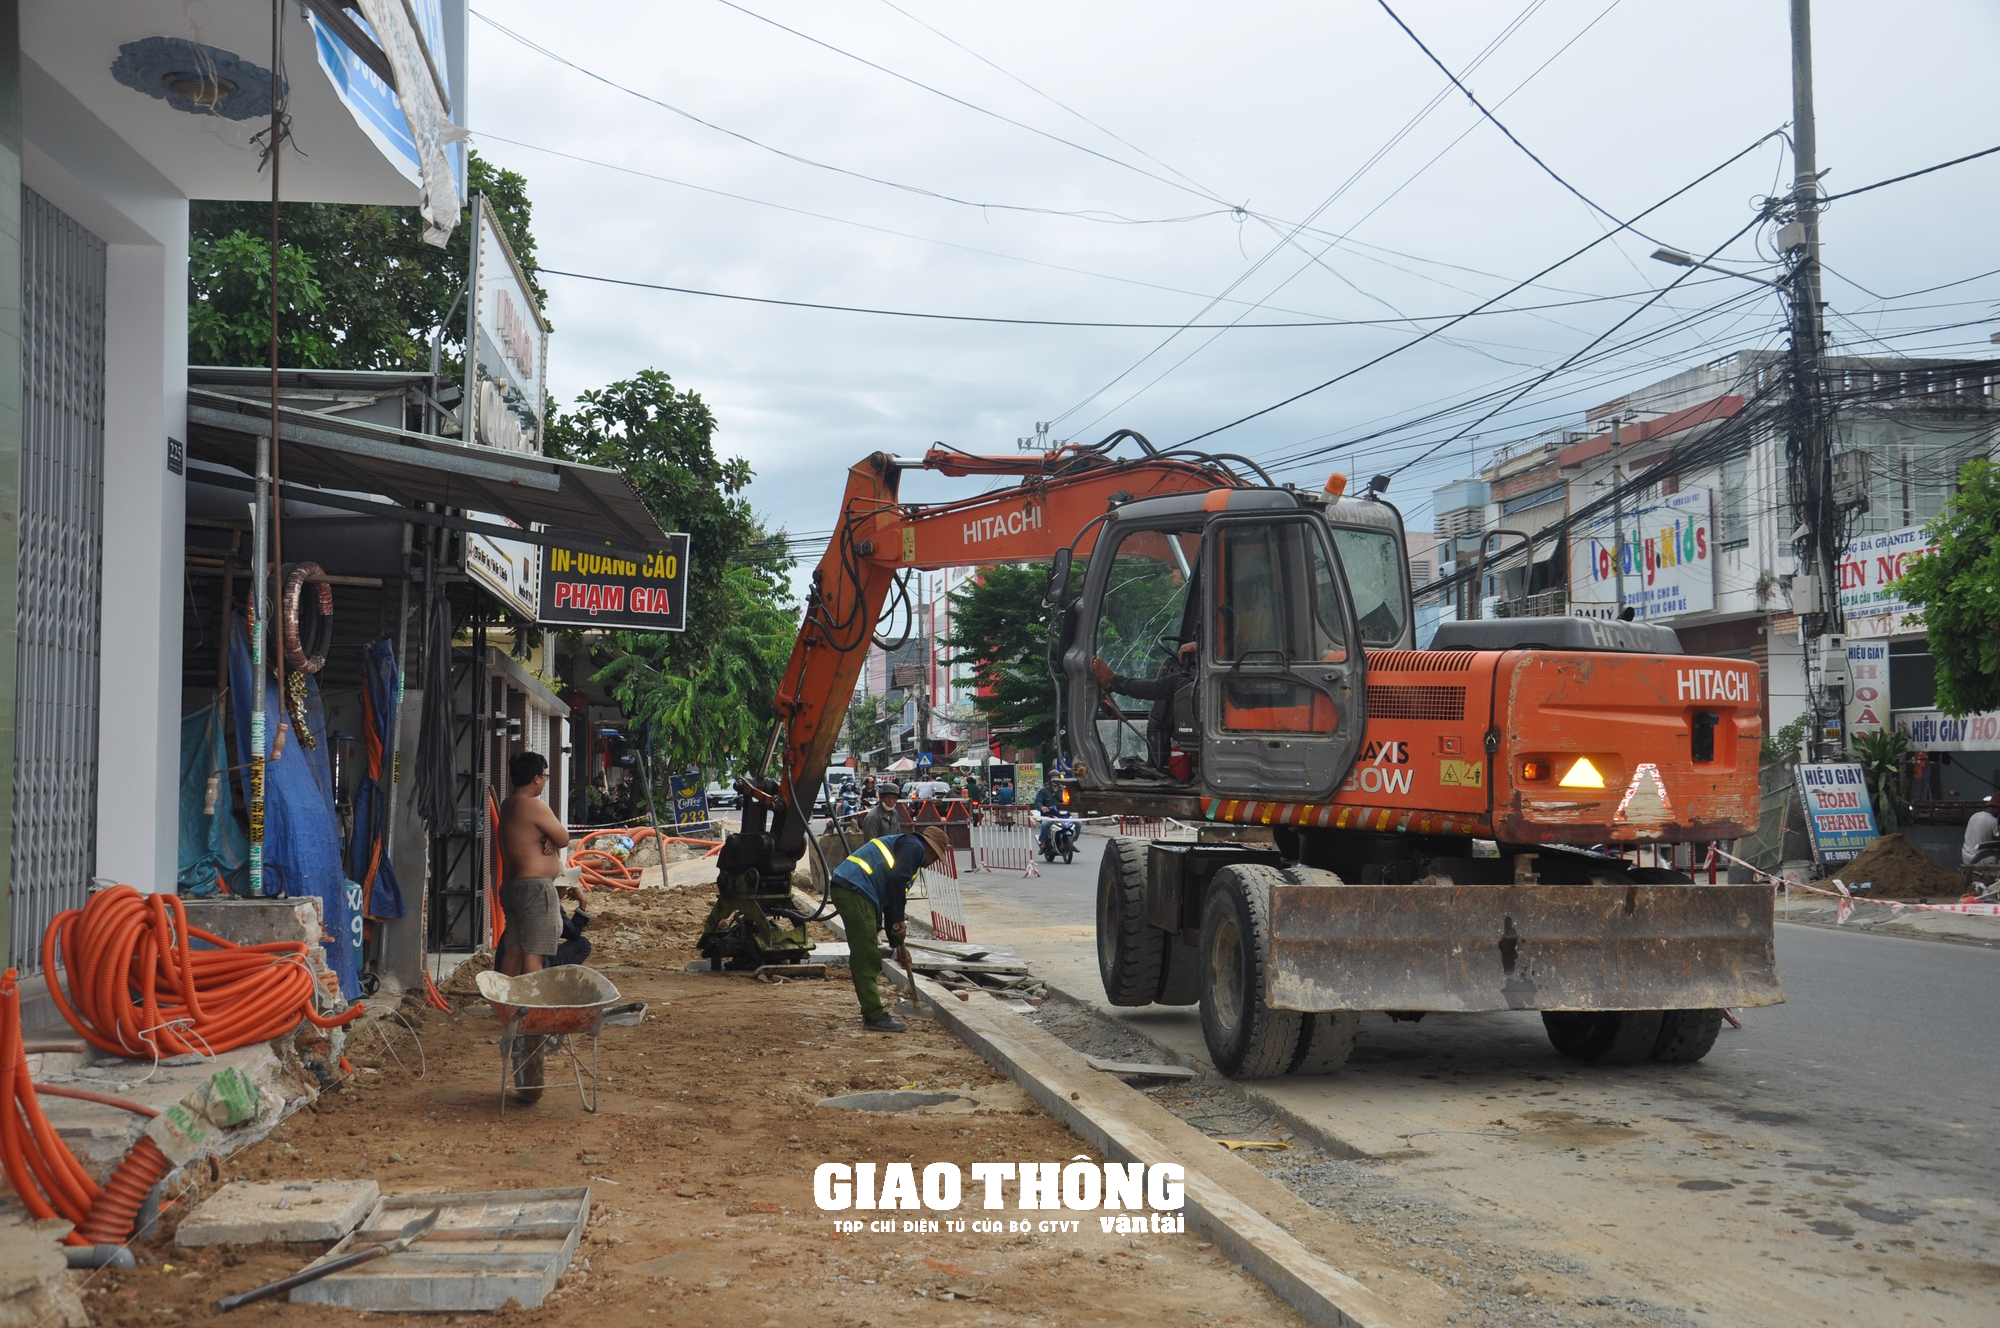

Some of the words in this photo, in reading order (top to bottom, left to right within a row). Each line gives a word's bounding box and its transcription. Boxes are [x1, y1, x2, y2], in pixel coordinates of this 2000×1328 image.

[170, 442, 181, 462] 225
[963, 505, 1042, 545] HITACHI
[1876, 531, 1916, 548] GRANITE
[642, 550, 677, 580] CÁO
[1834, 553, 1867, 591] ÍN
[554, 582, 624, 615] PHẠM
[630, 587, 670, 614] GIA
[1663, 600, 1676, 612] CHO
[1848, 645, 1866, 662] HIỆU
[1868, 644, 1884, 660] GIÀY
[1677, 669, 1749, 702] HITACHI
[1912, 715, 1936, 748] HIỆU
[1970, 716, 2000, 742] HO
[1357, 741, 1410, 766] AXIS
[1804, 766, 1834, 788] HIỆU
[1834, 765, 1862, 785] GIÀY
[677, 797, 702, 810] Coffee
[1816, 788, 1859, 809] HOÀN
[680, 810, 706, 828] 233
[1815, 814, 1869, 835] THẠNH
